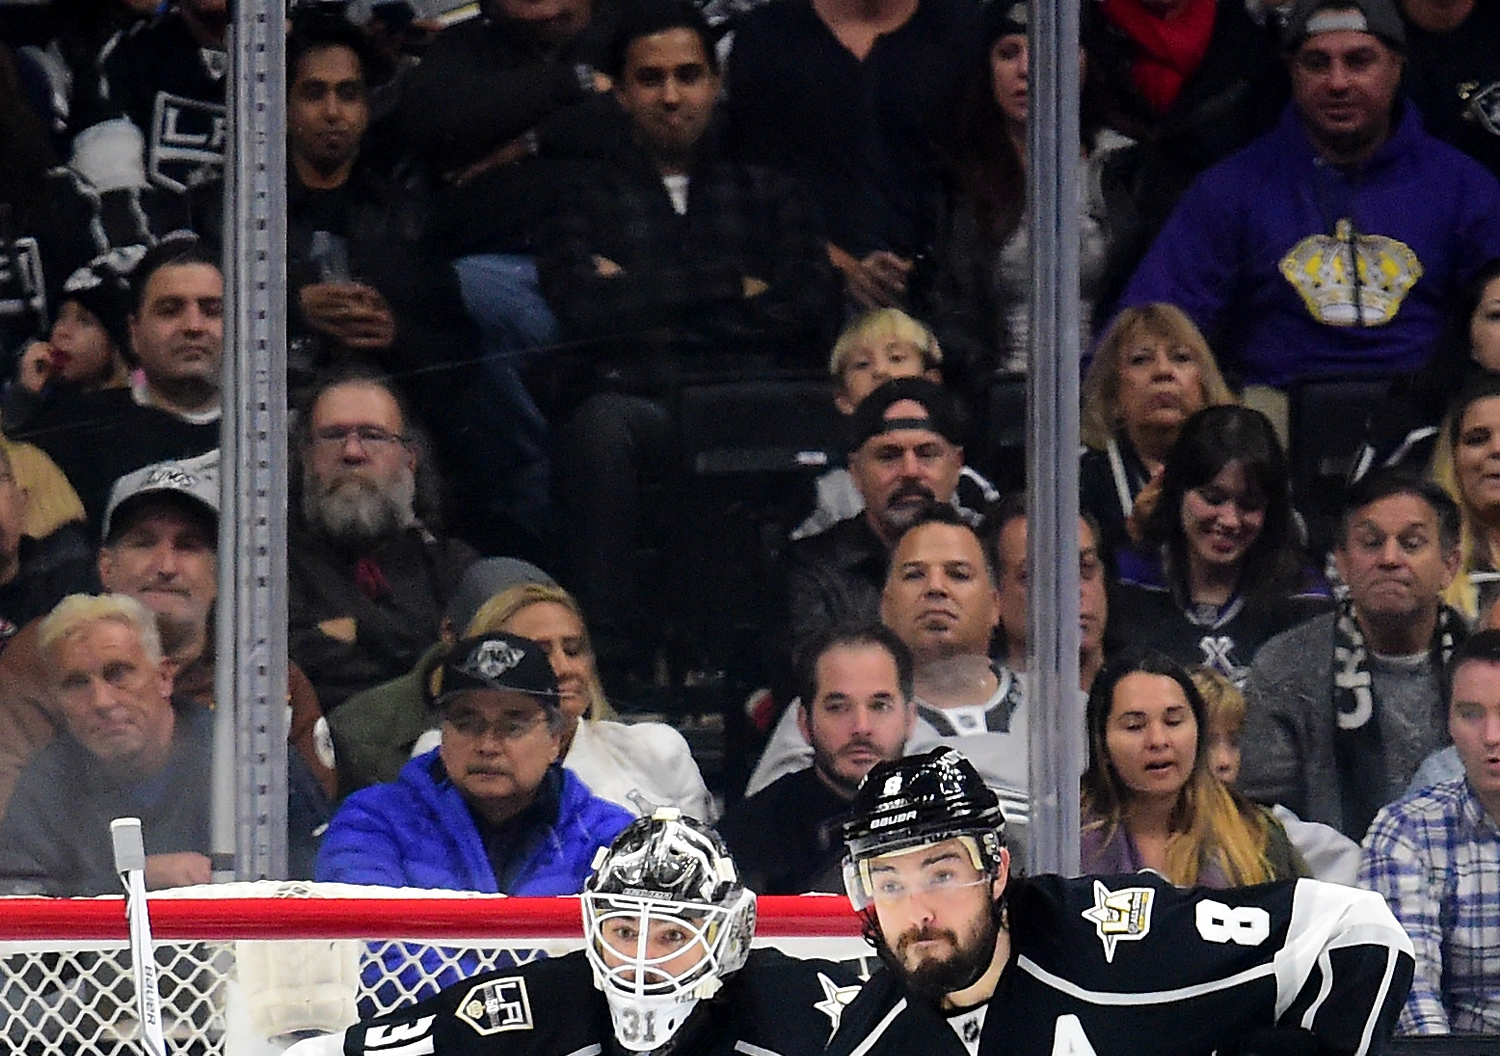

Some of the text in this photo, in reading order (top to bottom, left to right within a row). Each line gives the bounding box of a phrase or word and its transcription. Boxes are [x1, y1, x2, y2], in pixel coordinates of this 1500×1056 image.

[881, 773, 903, 796] 8
[1195, 898, 1270, 946] 8
[494, 982, 522, 1024] LA
[621, 1006, 657, 1042] 31
